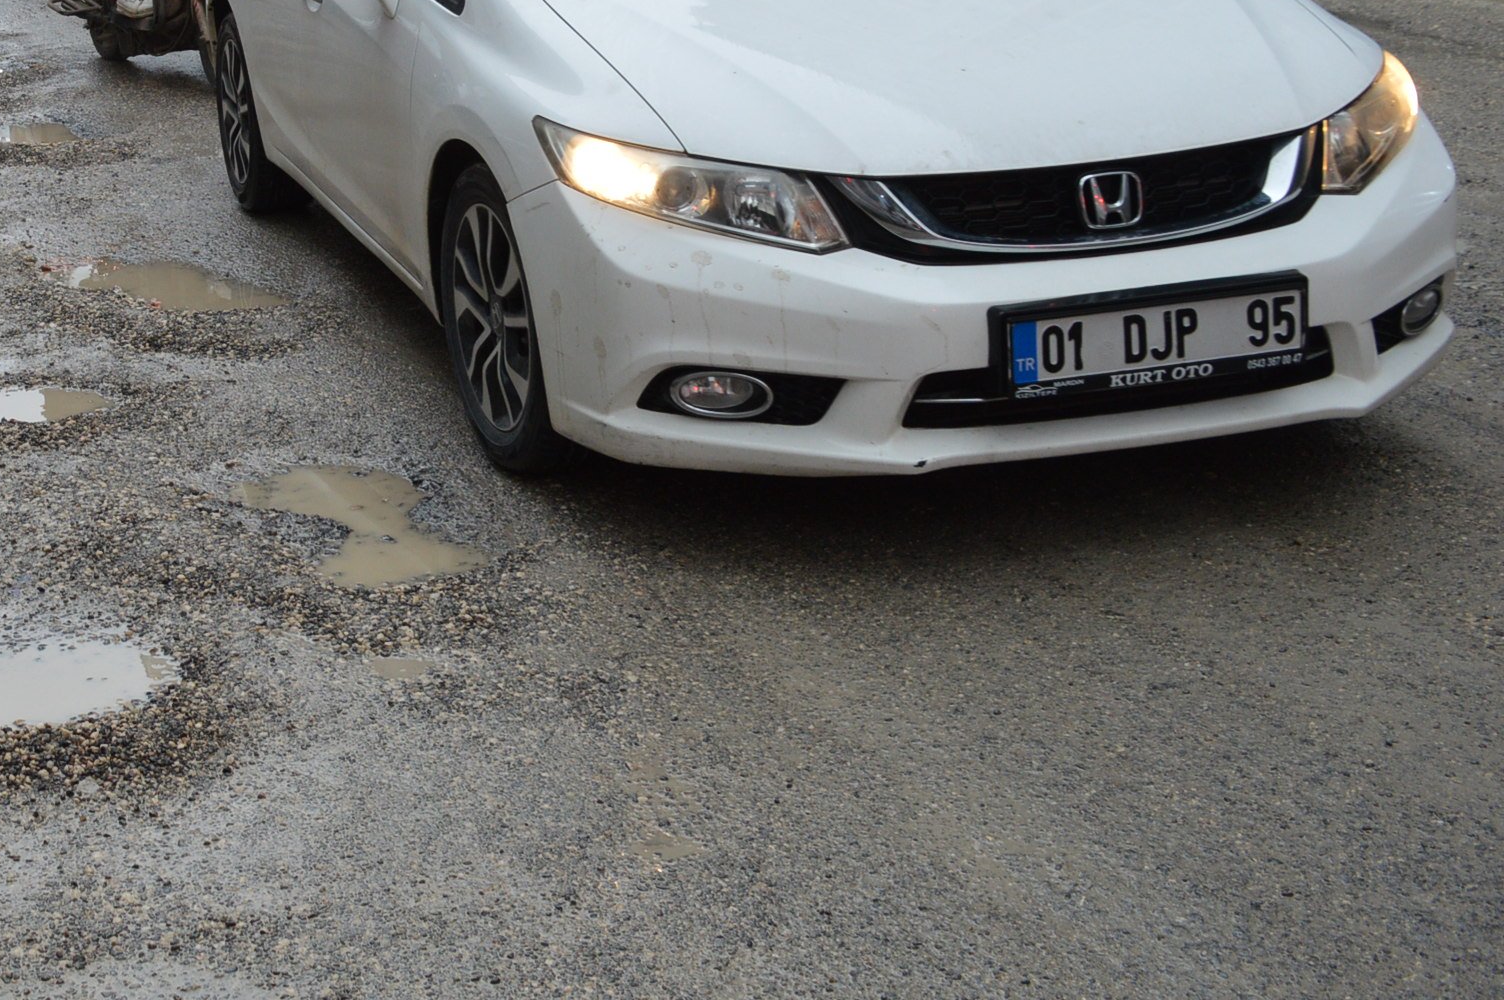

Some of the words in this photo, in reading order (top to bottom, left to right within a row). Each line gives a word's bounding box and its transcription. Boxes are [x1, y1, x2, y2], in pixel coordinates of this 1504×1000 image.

[1041, 321, 1084, 374] 01
[1122, 307, 1199, 365] DJP
[1246, 296, 1296, 347] 95
[1016, 357, 1036, 373] TR
[1109, 368, 1167, 389] KURT
[1170, 362, 1214, 381] OTO
